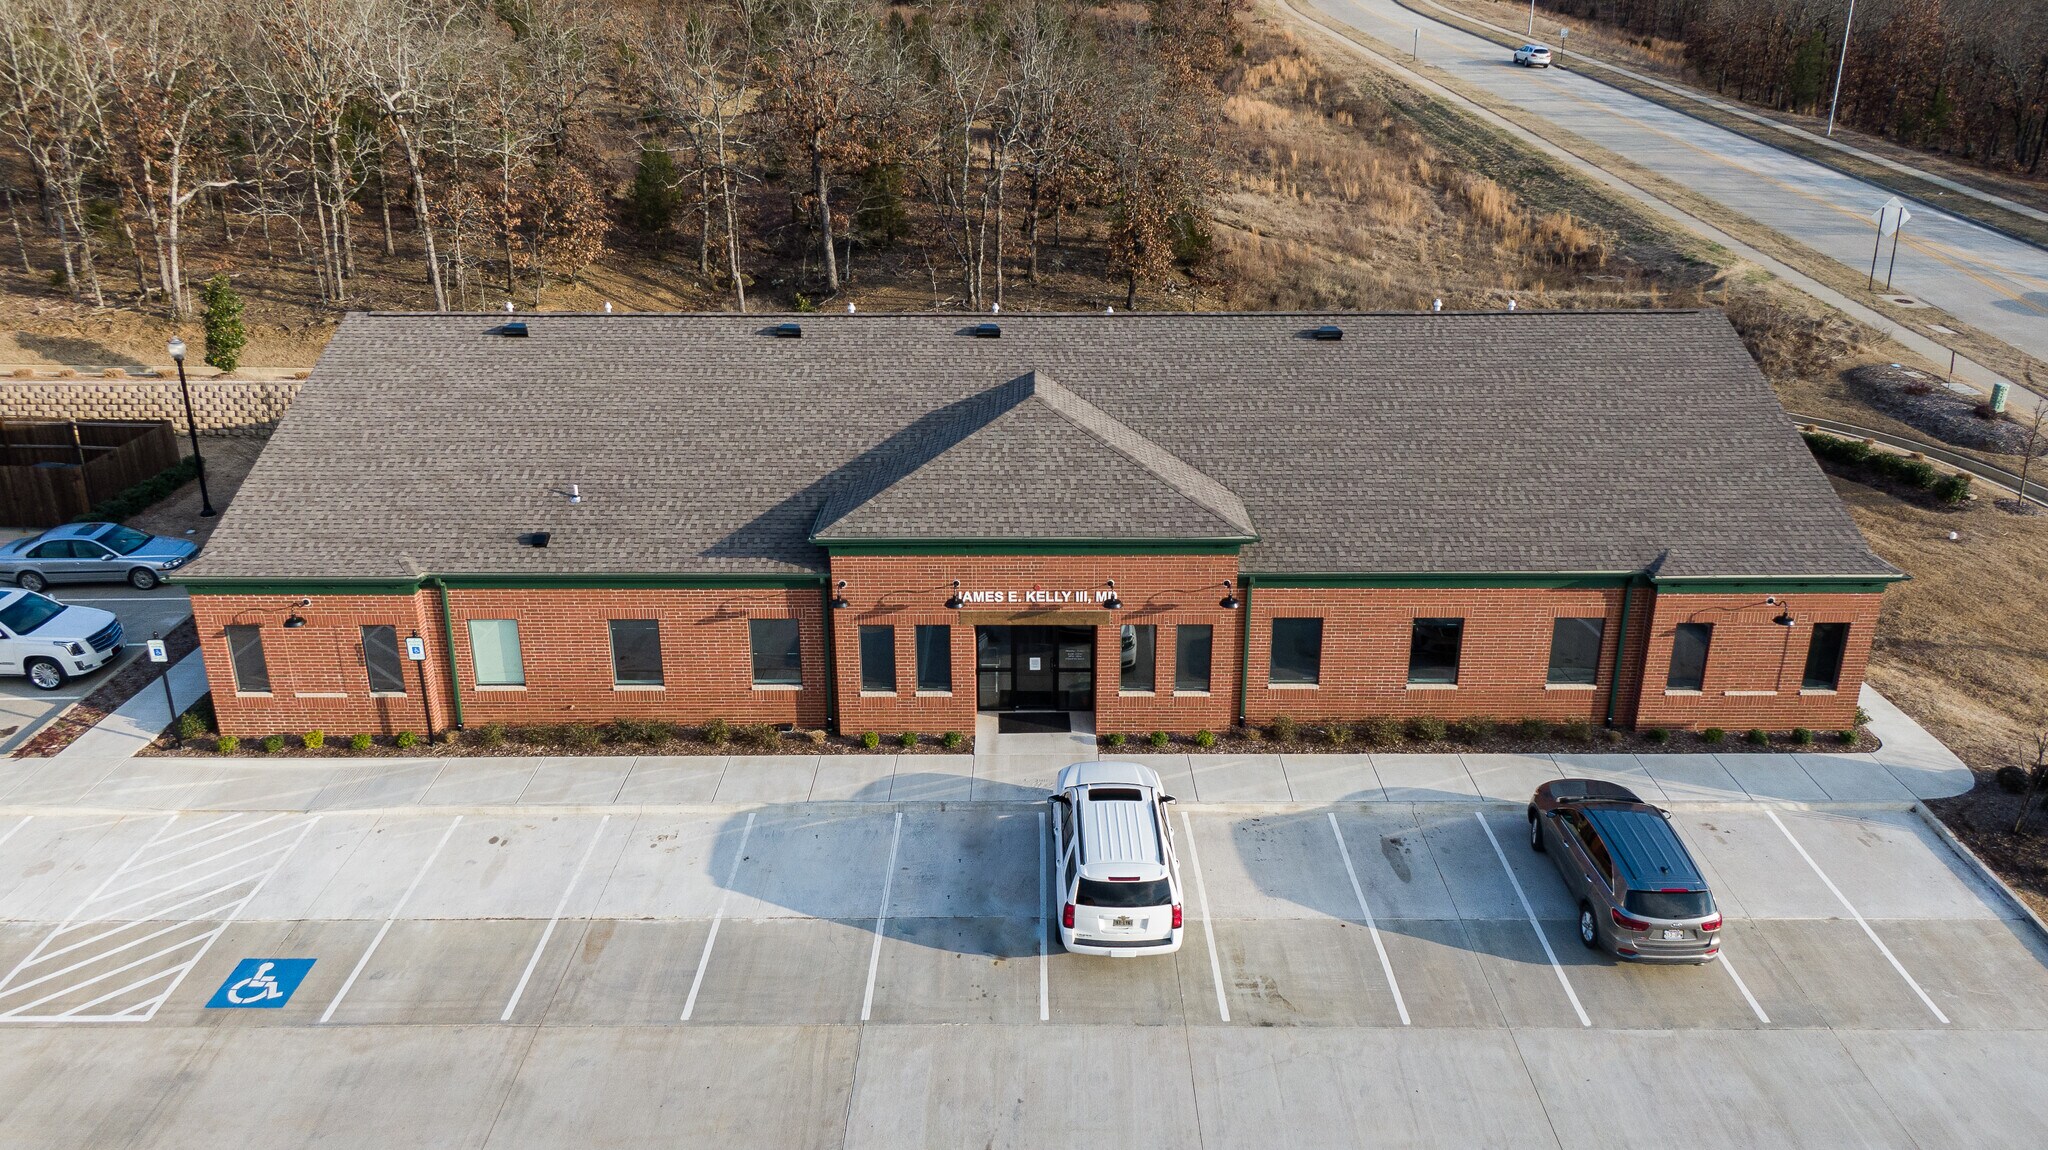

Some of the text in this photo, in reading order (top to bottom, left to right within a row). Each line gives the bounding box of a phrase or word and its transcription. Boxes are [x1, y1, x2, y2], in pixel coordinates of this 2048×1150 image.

[1008, 591, 1021, 603] E.
[1025, 591, 1072, 603] KELLY
[1075, 591, 1092, 604] III,
